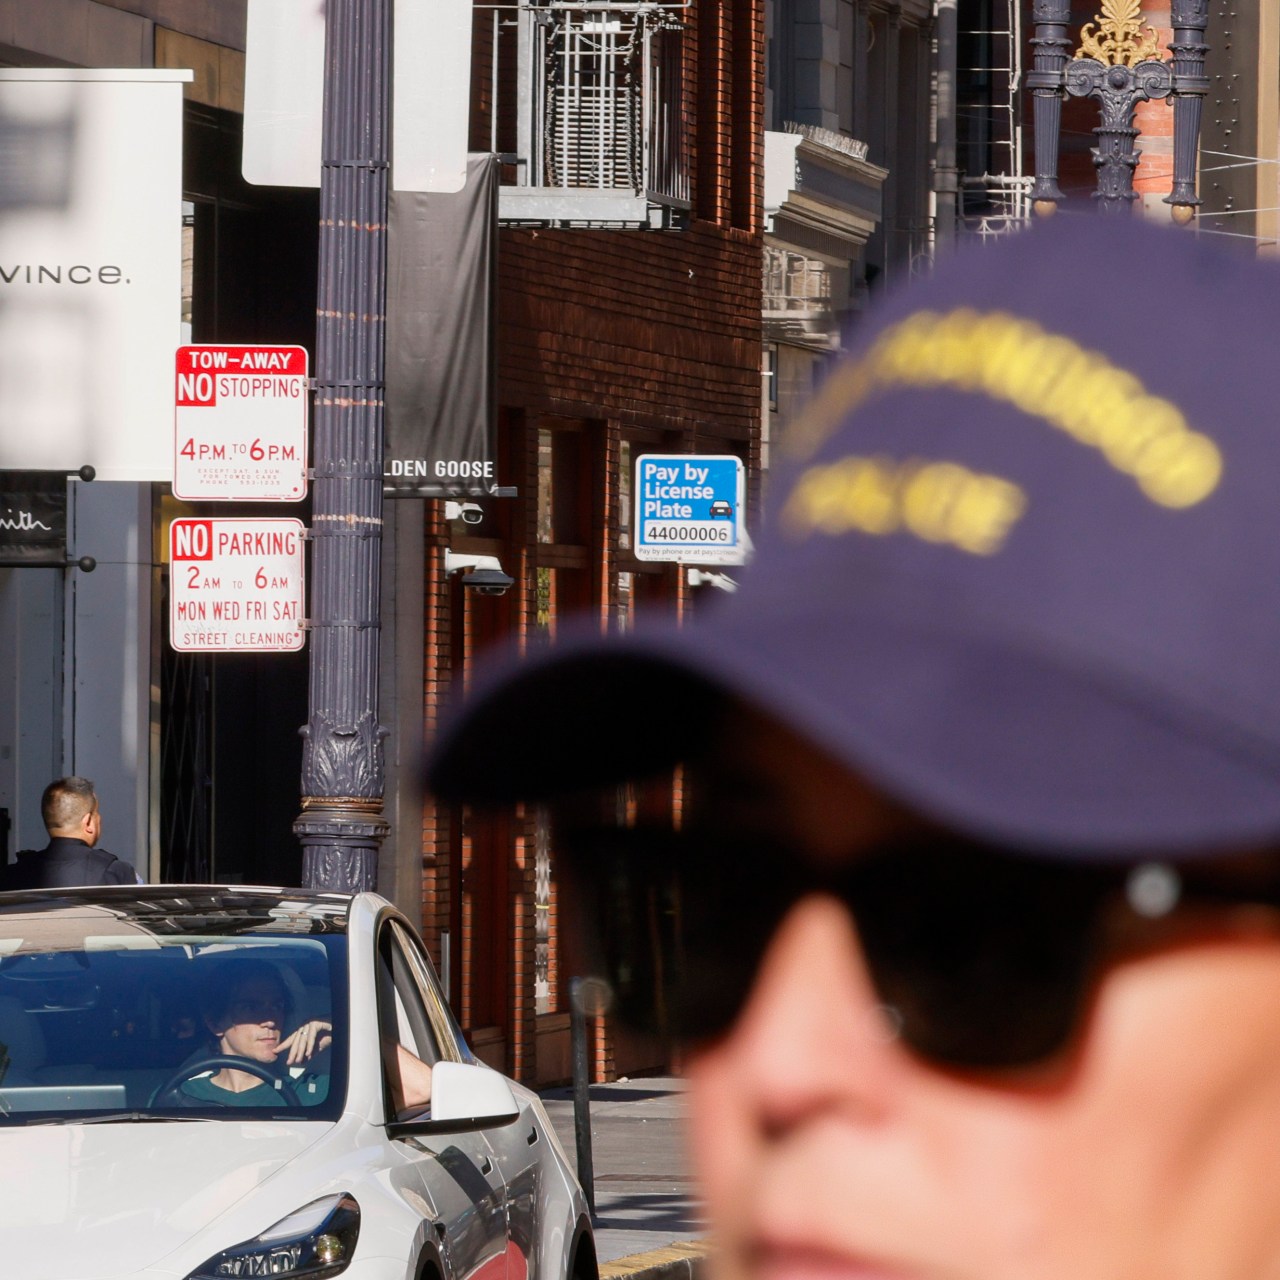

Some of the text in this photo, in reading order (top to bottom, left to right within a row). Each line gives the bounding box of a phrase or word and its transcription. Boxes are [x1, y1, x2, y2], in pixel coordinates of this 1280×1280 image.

[189, 351, 292, 369] TOW-AWAY
[178, 373, 300, 402] NO STOPPING
[232, 444, 247, 454] TO
[435, 460, 494, 478] GOOSE
[645, 463, 709, 485] Pay by
[645, 482, 714, 499] License
[645, 500, 693, 518] Plate
[176, 524, 296, 557] NO PARKING
[648, 526, 728, 541] 44000006
[652, 548, 660, 556] by
[662, 548, 683, 556] phone
[187, 566, 288, 589] 2 AM TO 6 AM
[178, 601, 297, 621] MON WED FRI SAT
[184, 632, 293, 645] STREET CLEANING
